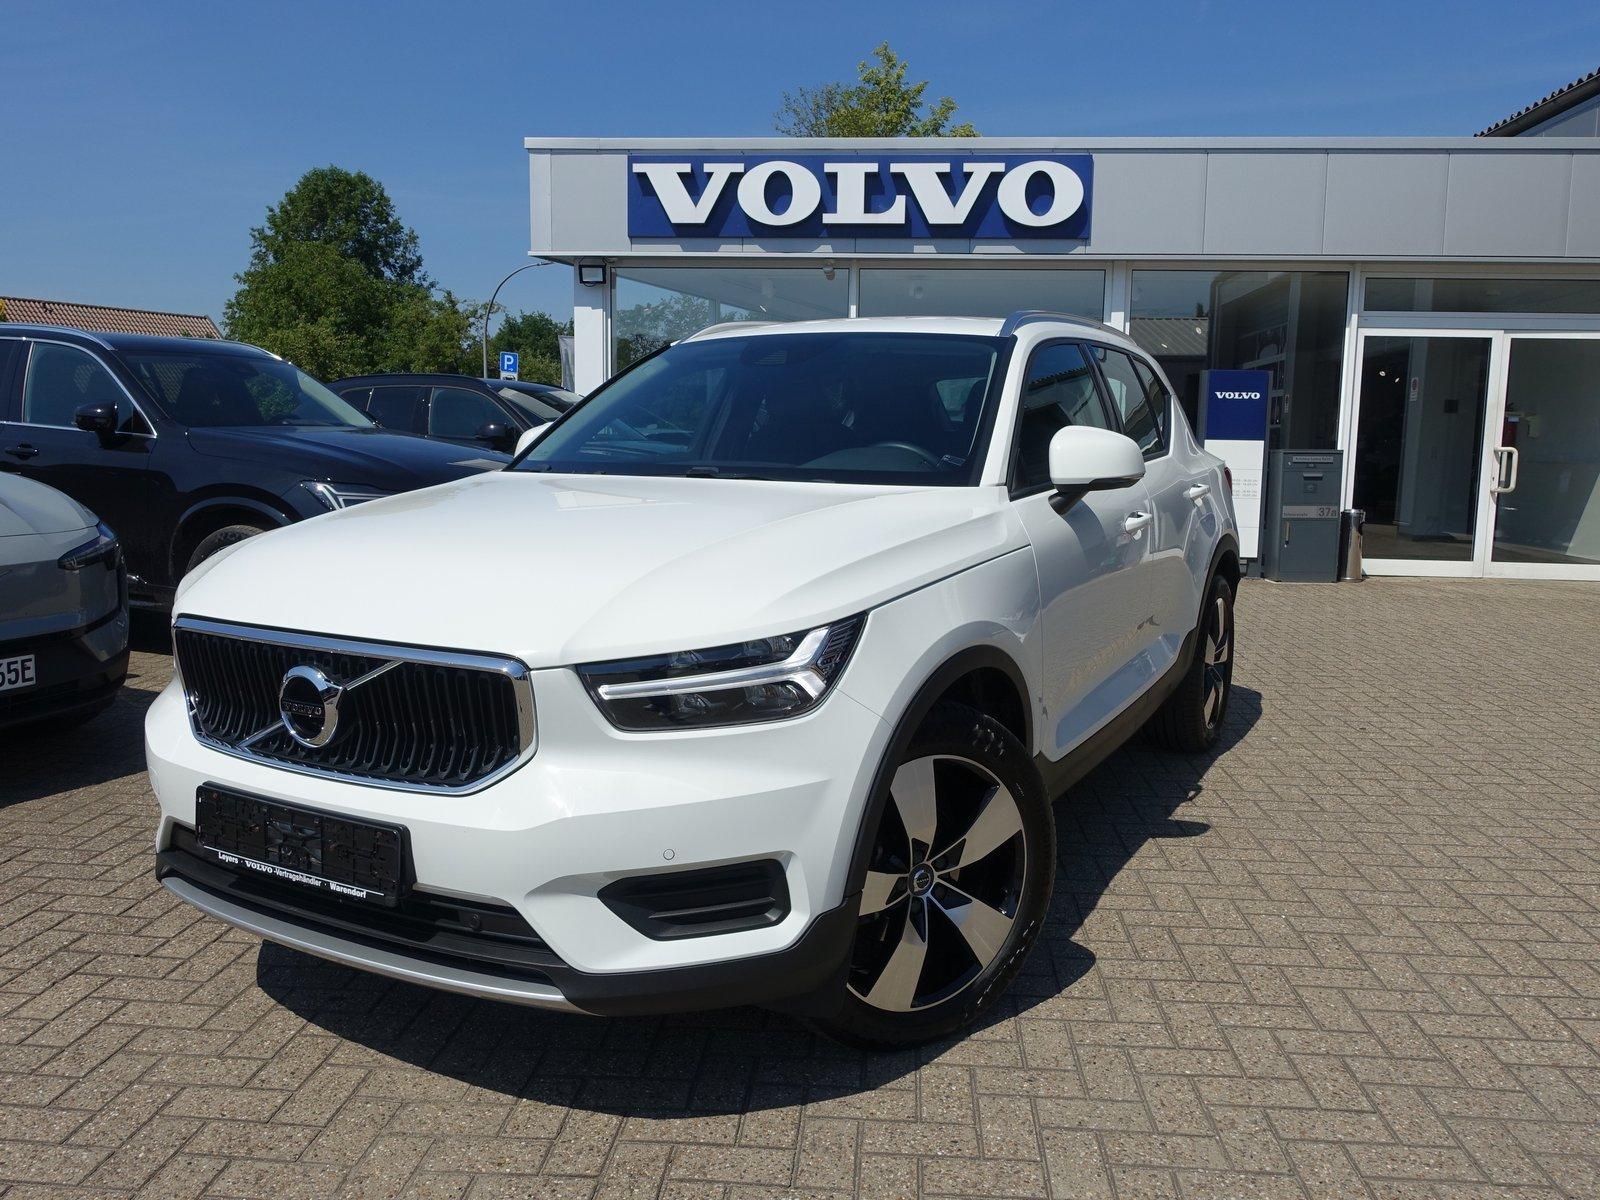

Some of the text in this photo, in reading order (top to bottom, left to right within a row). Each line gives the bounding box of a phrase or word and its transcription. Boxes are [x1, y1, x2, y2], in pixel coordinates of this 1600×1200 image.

[632, 160, 1085, 227] VOLVO
[504, 354, 515, 371] P
[1214, 391, 1261, 400] VOLVO
[1318, 507, 1338, 517] 37a
[284, 701, 323, 716] VOLVO
[218, 851, 239, 864] Leyers
[244, 860, 273, 874] VOLVO
[329, 882, 367, 898] Warendorf
